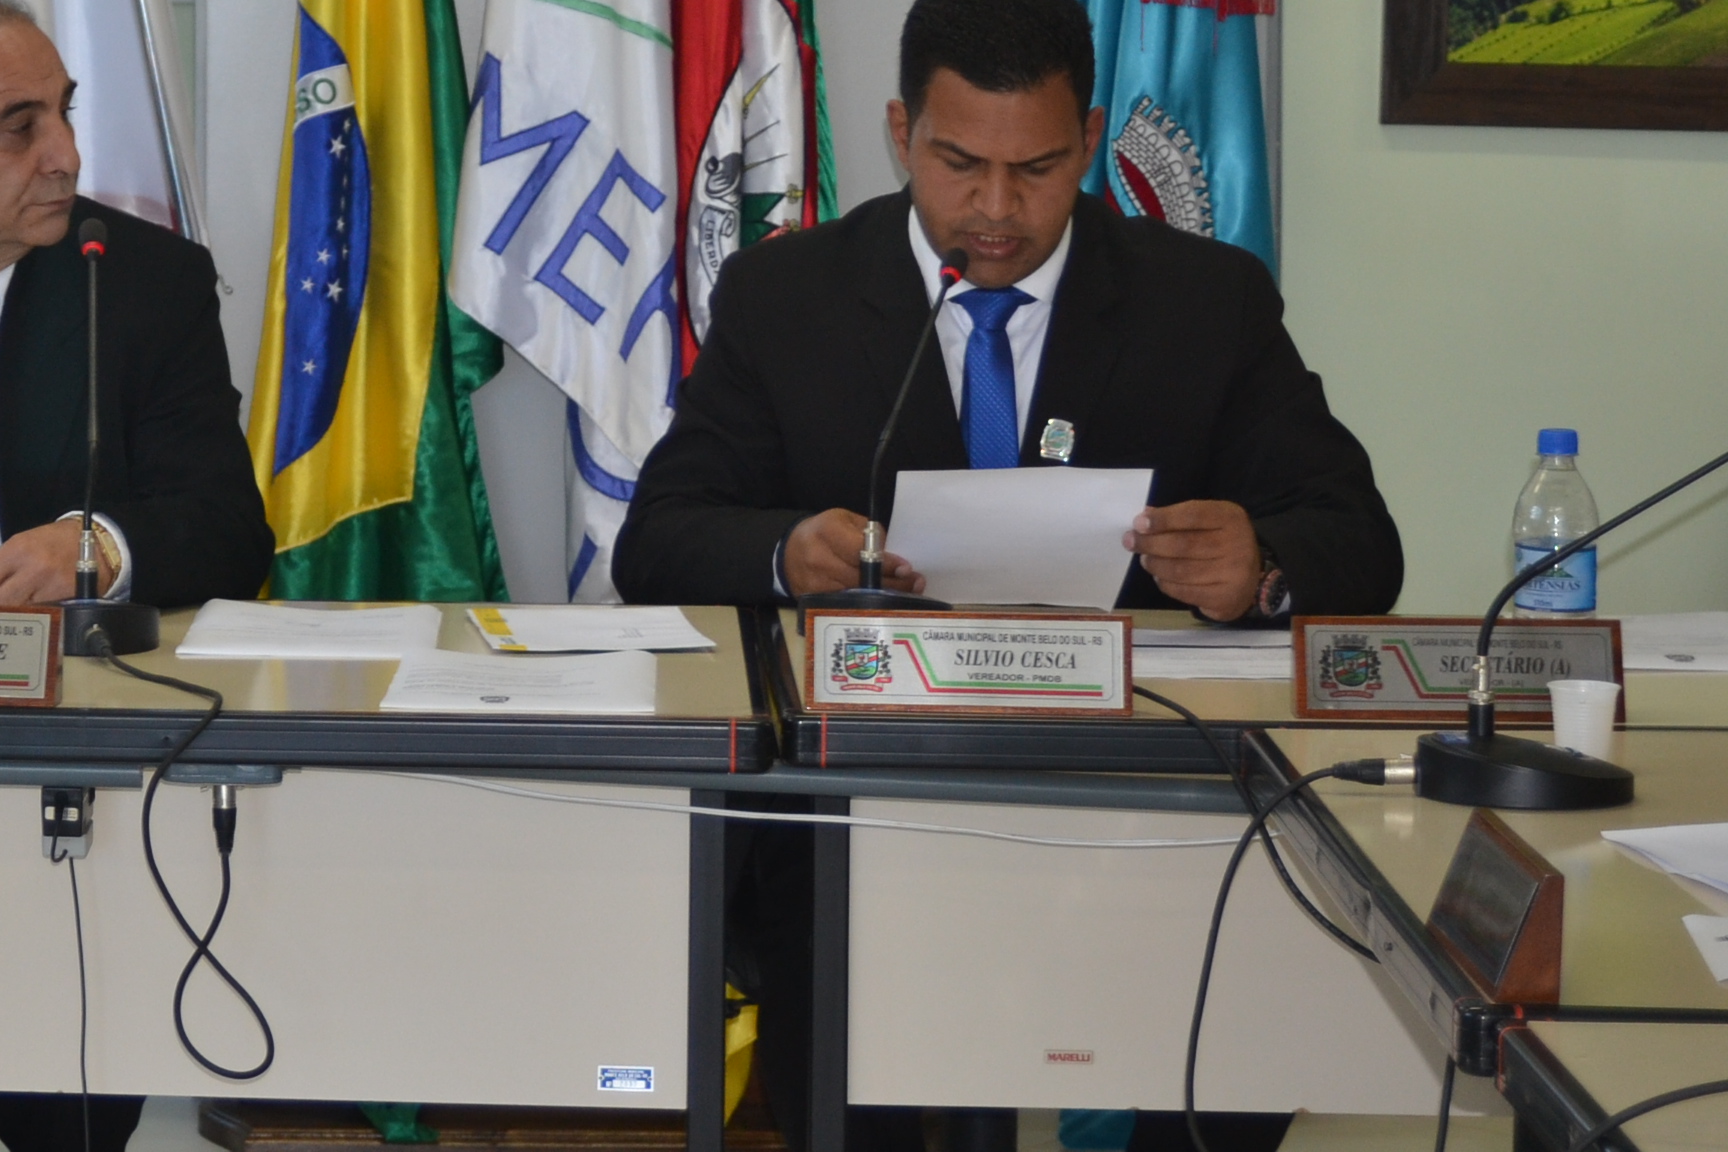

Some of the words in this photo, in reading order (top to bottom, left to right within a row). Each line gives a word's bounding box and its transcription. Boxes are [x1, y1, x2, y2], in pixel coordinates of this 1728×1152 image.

[704, 219, 720, 273] LIBERD
[3, 626, 18, 636] SUL
[23, 626, 33, 636] RS
[923, 629, 955, 641] CÂMARA
[956, 632, 996, 643] MUNICIPAL
[998, 633, 1008, 643] DE
[1010, 633, 1037, 644] MONTE
[1038, 634, 1058, 644] BELO
[1059, 635, 1070, 645] DO
[1071, 635, 1086, 645] SUL
[1092, 636, 1102, 646] RS
[954, 648, 1014, 667] SILVIO
[1020, 651, 1077, 670] CESCA
[1439, 651, 1544, 674] SECTÁRIO
[1550, 658, 1571, 676] (A)
[967, 672, 1024, 682] VEREADOR
[1032, 674, 1062, 683] PMDB
